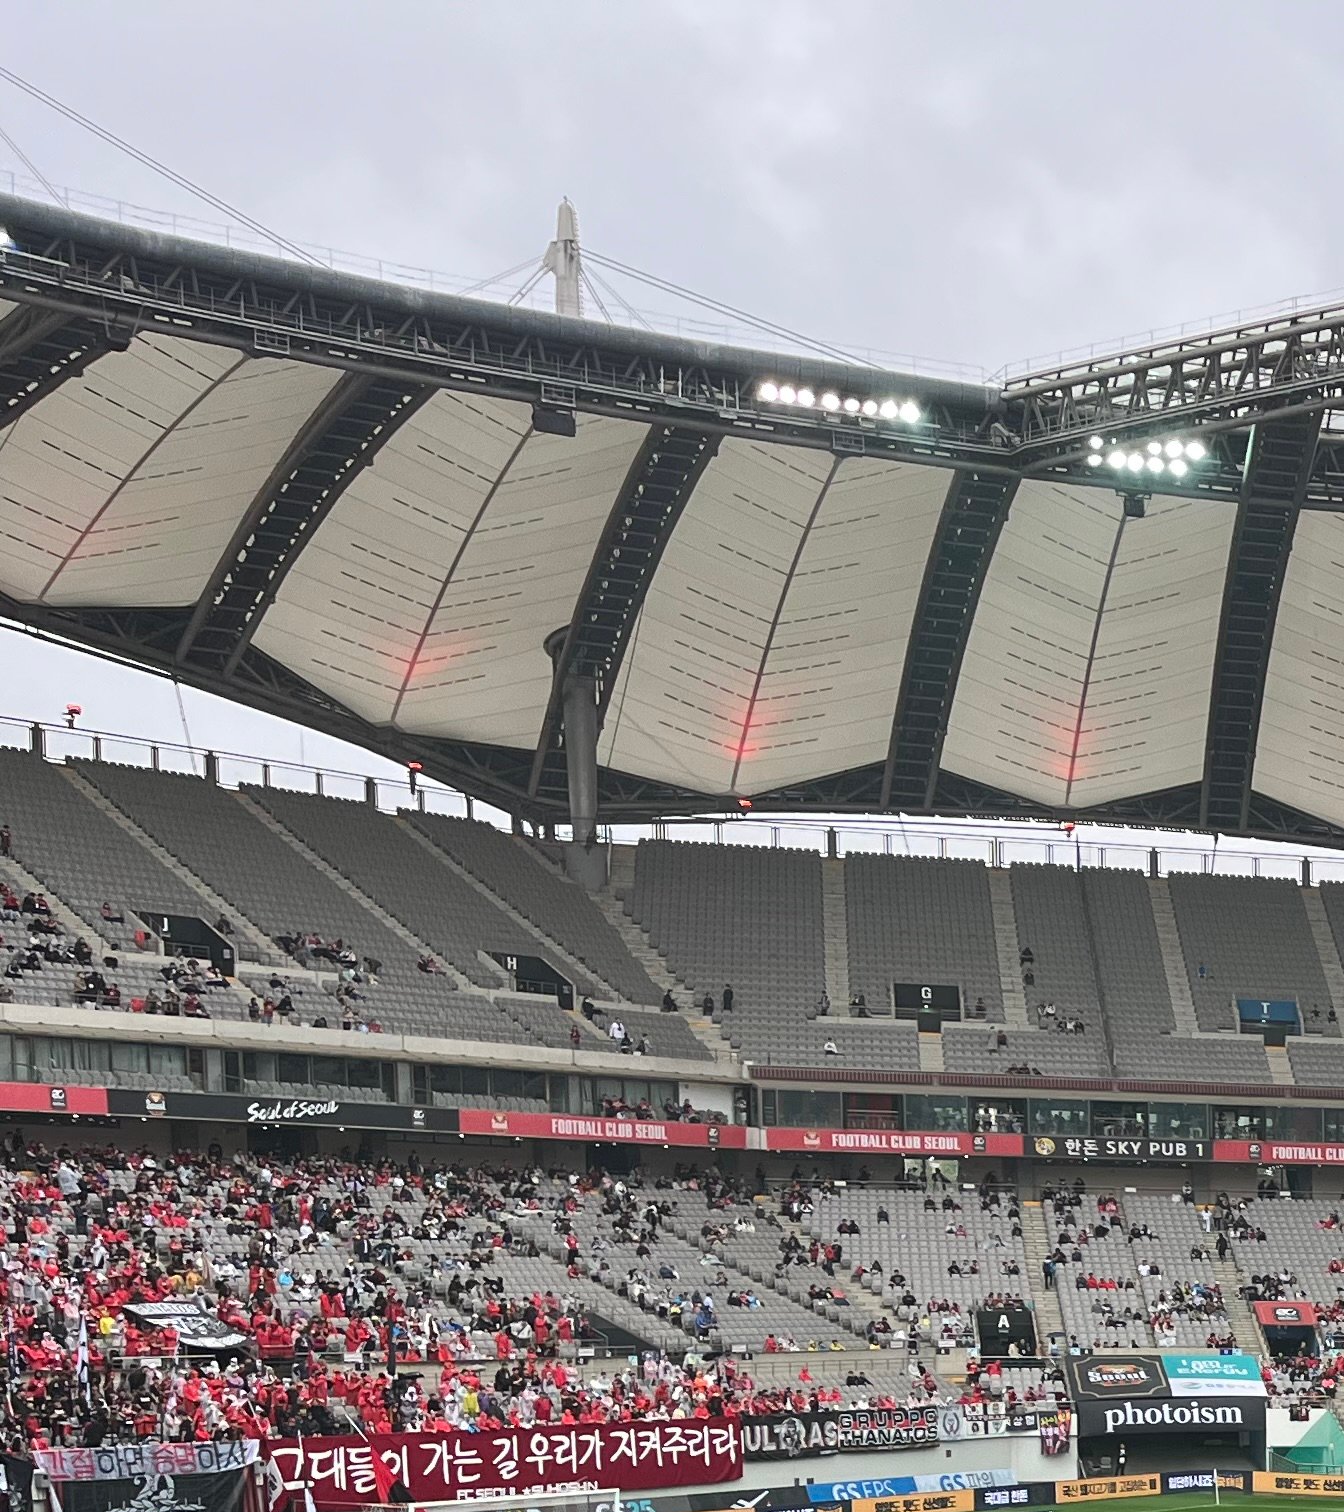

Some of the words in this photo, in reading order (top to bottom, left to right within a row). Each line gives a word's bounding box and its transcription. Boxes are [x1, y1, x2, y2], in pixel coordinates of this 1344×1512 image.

[296, 1101, 338, 1117] Seoul
[552, 1118, 603, 1137] FOOTBALL
[605, 1121, 632, 1138] CLUB
[635, 1122, 667, 1139] SEOUL
[832, 1133, 888, 1148] FOOTBALL
[890, 1134, 921, 1149] CLUB
[924, 1136, 960, 1150] SEOUL
[1065, 1139, 1099, 1156] 한돈
[1105, 1141, 1141, 1155] SKY
[1149, 1142, 1187, 1156] PUB
[1196, 1143, 1203, 1156] 1
[1272, 1146, 1323, 1161] FOOTBALL
[998, 1314, 1010, 1329] A
[1104, 1401, 1243, 1433] photoism
[840, 1424, 938, 1444] THANATOS
[271, 1444, 409, 1494] 그대들이
[419, 1438, 483, 1486] 가는
[493, 1435, 519, 1480] 길
[525, 1429, 605, 1475] 우리가
[610, 1424, 738, 1467] 지켜주리라
[832, 1483, 861, 1499] GS
[939, 1475, 965, 1491] GS
